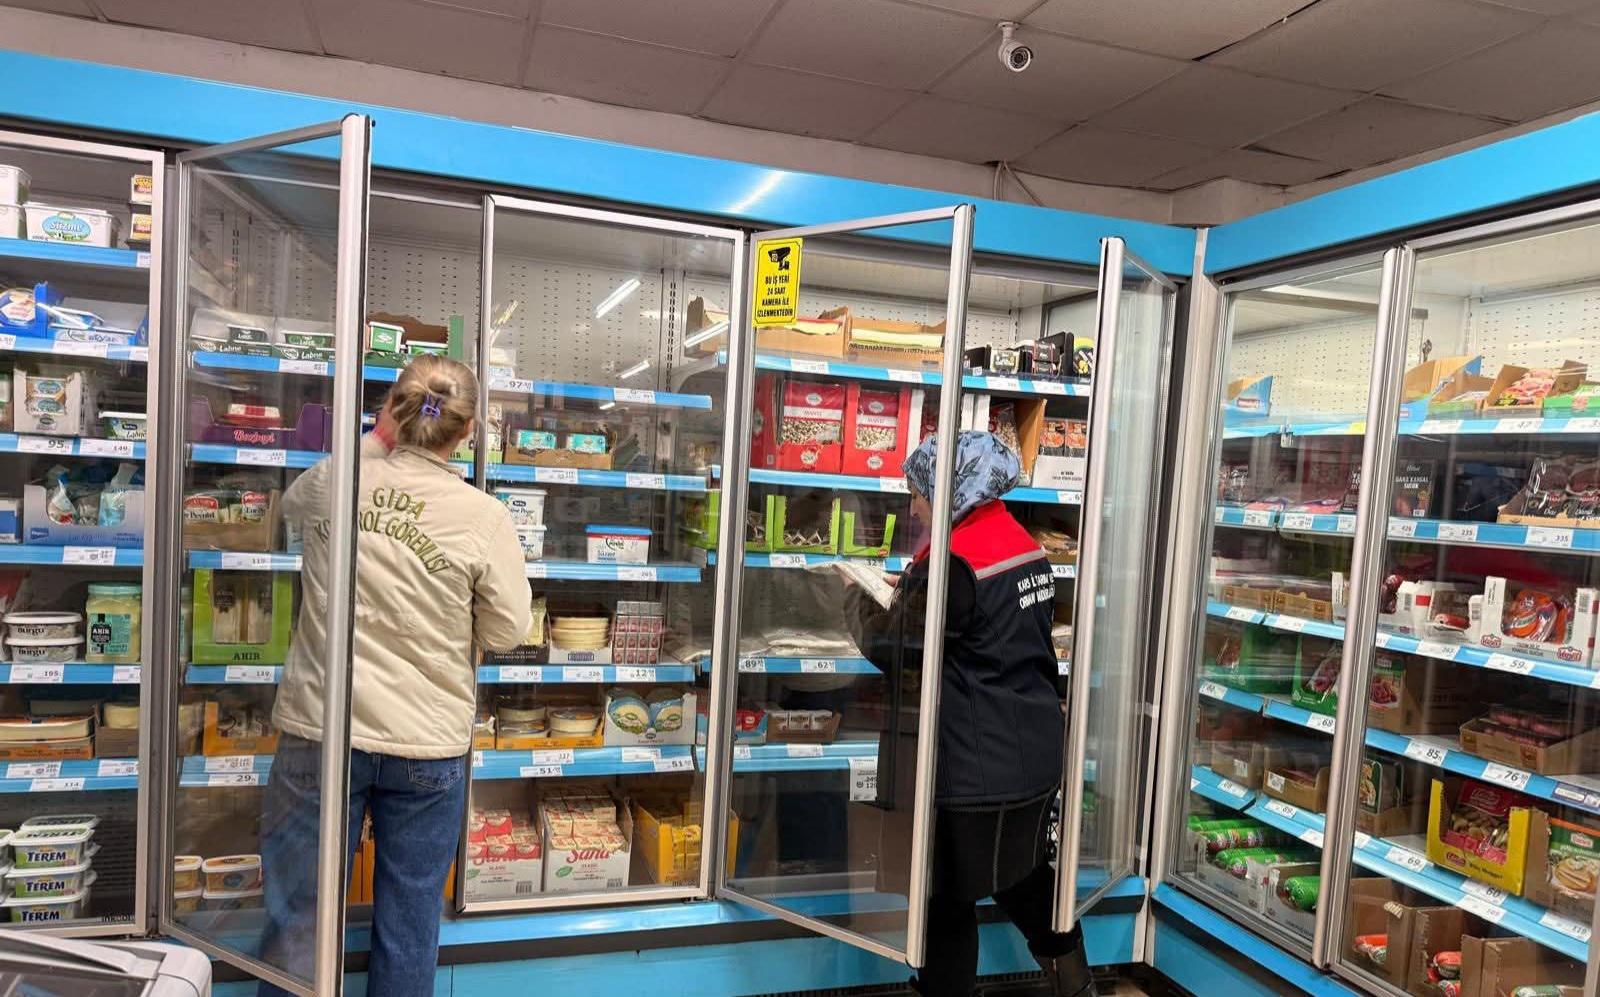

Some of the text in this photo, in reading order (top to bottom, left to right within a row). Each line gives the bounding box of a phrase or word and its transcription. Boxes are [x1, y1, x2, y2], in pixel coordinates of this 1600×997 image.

[765, 275, 772, 285] BU
[778, 274, 790, 284] YERİ
[767, 287, 786, 296] 24 SAAT
[761, 298, 781, 306] KAMERA
[47, 438, 65, 450] 95
[372, 487, 426, 520] GIDA
[1017, 577, 1031, 594] KARS
[1019, 593, 1036, 610] ORMAN
[1425, 748, 1440, 761] 85
[235, 774, 252, 783] 29
[1503, 770, 1519, 782] 76
[27, 851, 67, 863] TEREM
[26, 881, 65, 892] TEREM
[21, 910, 60, 922] TEREM
